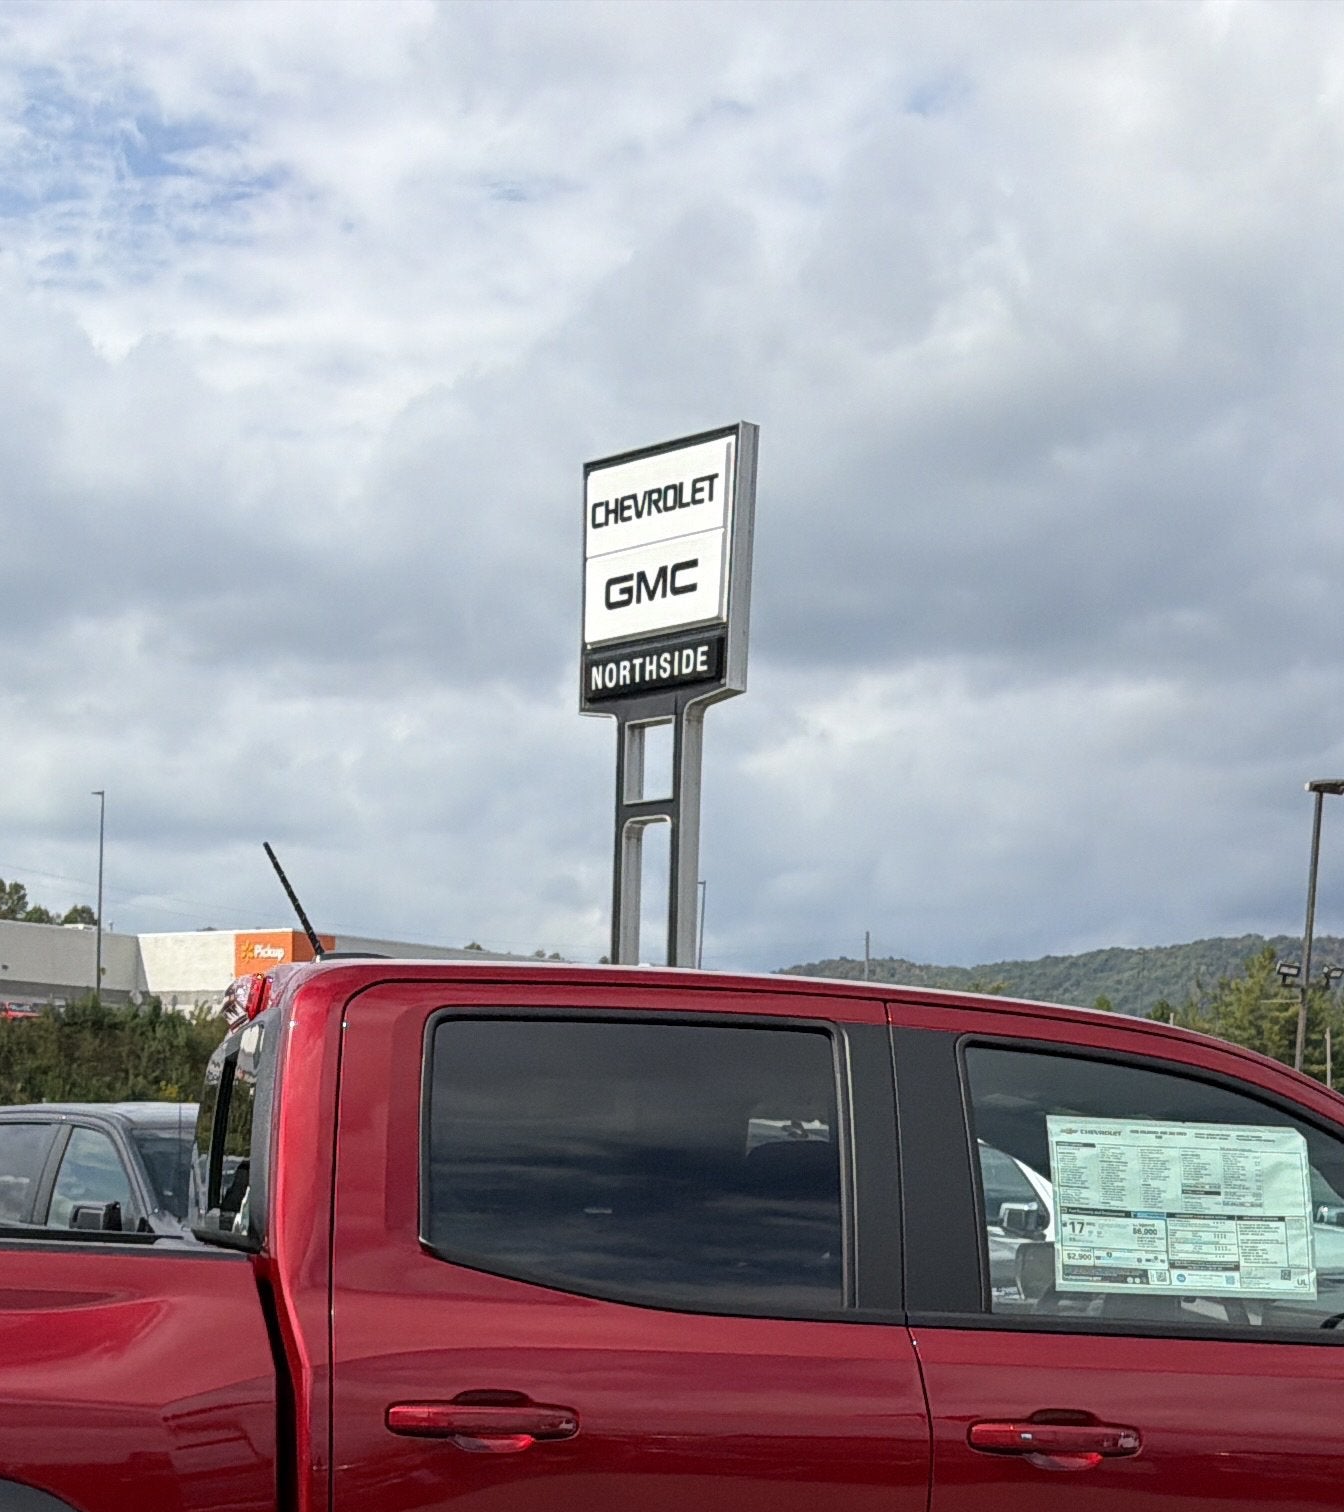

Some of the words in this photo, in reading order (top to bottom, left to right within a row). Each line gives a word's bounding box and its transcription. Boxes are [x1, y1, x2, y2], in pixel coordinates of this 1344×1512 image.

[590, 472, 719, 530] CHEVROLET
[604, 558, 699, 611] GMC
[590, 645, 709, 691] NORTHSIDE
[254, 944, 285, 962] Pickup
[1080, 1128, 1123, 1137] CHEVROLET
[1068, 1221, 1084, 1234] 17
